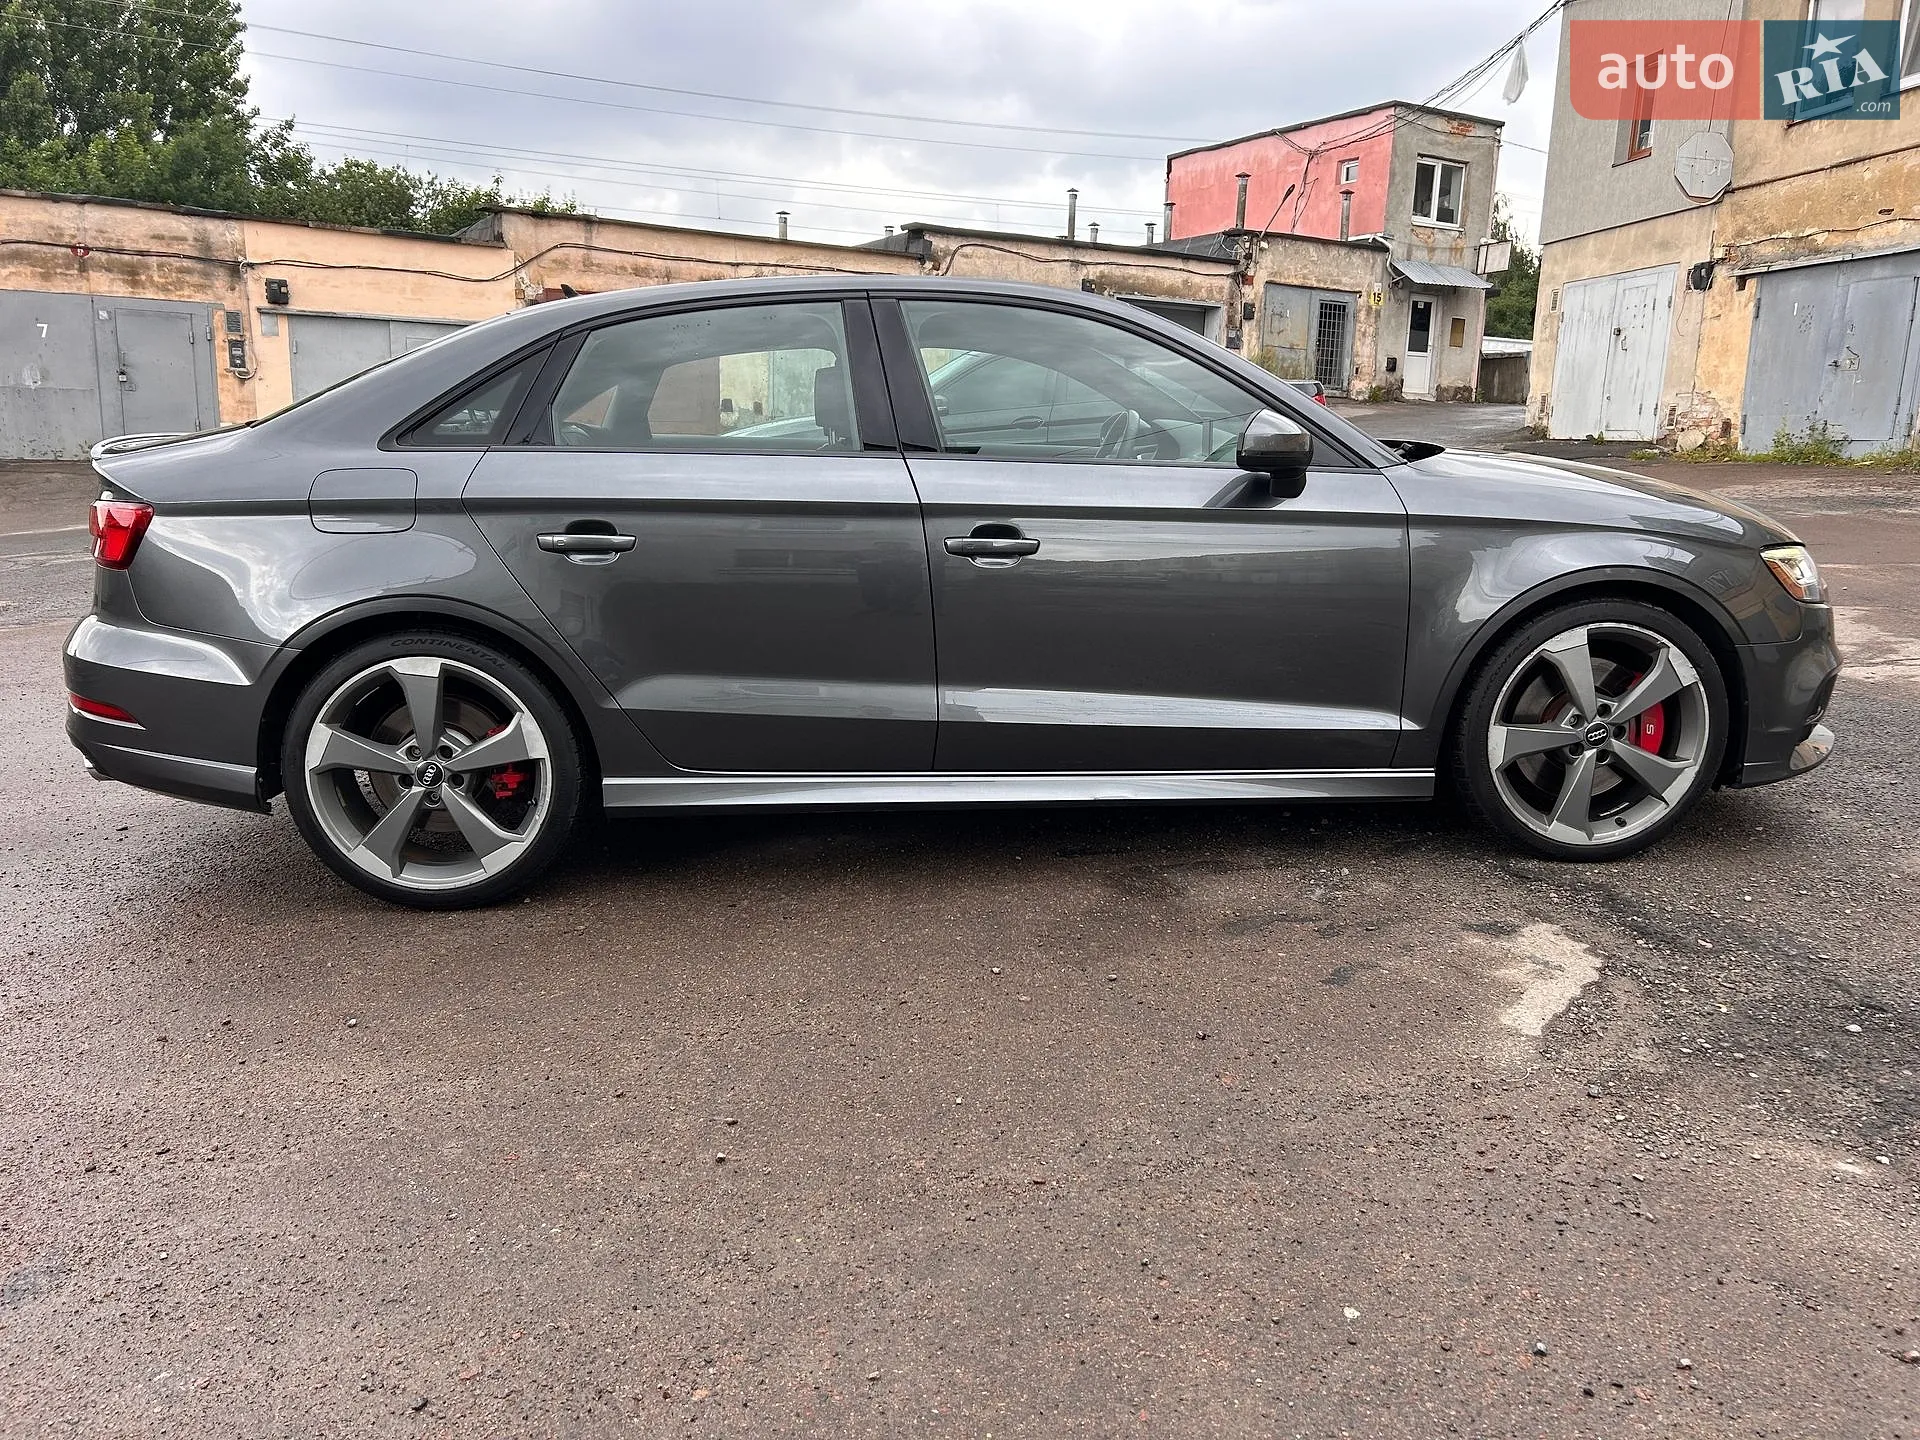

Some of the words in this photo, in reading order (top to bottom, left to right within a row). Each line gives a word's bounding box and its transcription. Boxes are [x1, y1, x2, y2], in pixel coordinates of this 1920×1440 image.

[1373, 292, 1382, 304] 15
[37, 323, 49, 338] 7
[391, 638, 505, 669] CONTINENTAL
